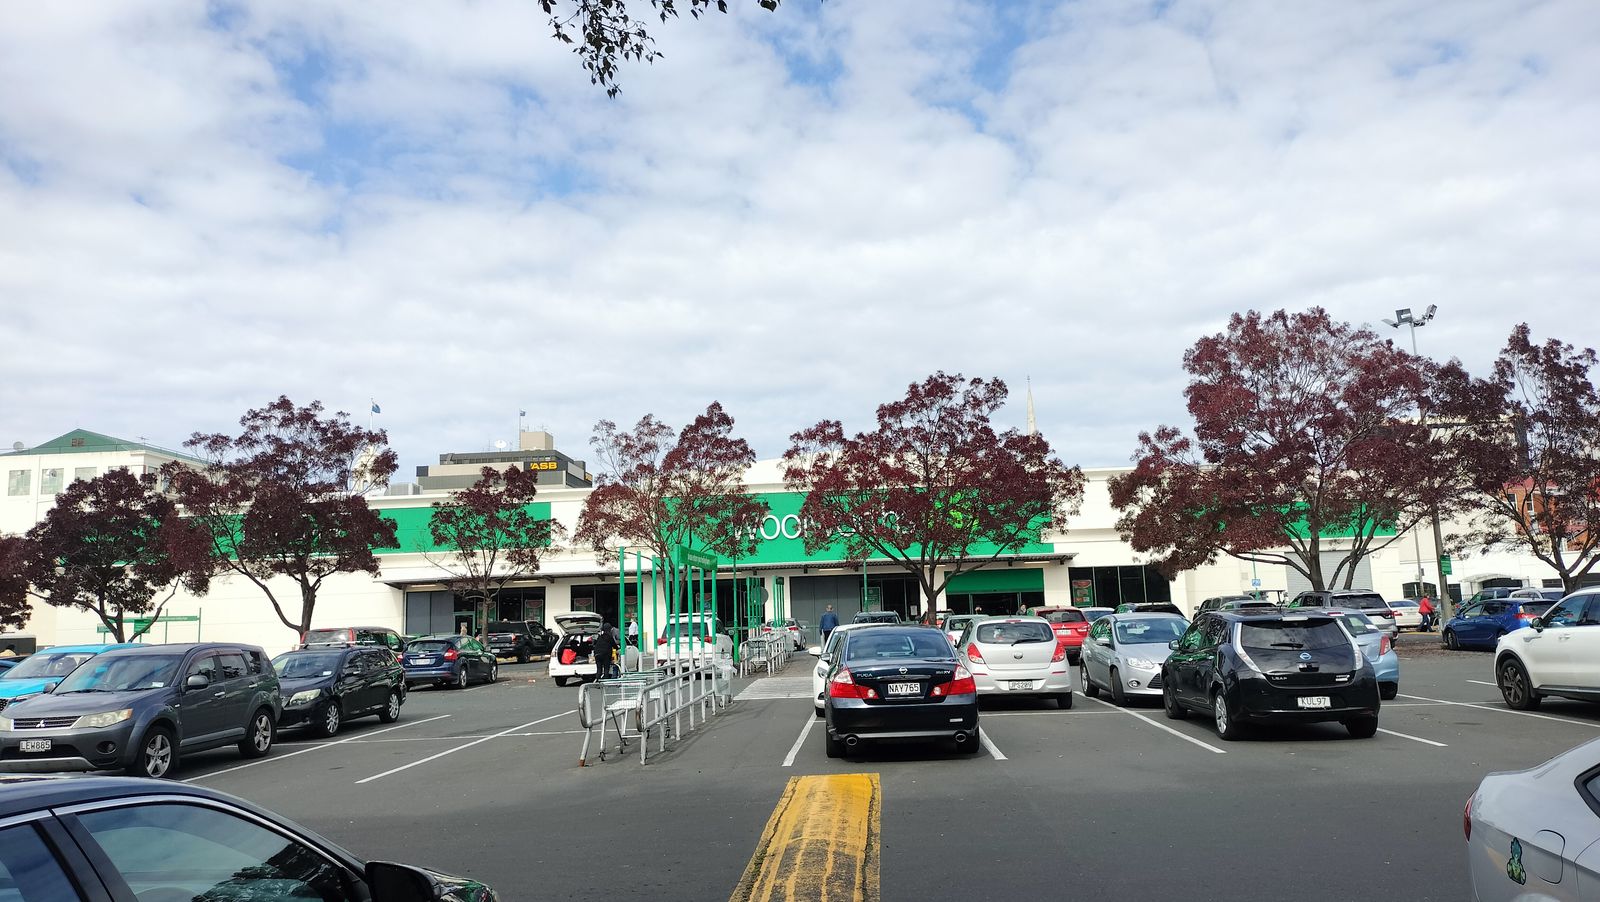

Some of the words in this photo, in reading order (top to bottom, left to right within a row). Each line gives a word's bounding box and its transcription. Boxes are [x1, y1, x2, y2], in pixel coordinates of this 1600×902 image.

[531, 462, 557, 470] ASB
[888, 683, 919, 693] NAY765
[1301, 697, 1327, 706] KUL97
